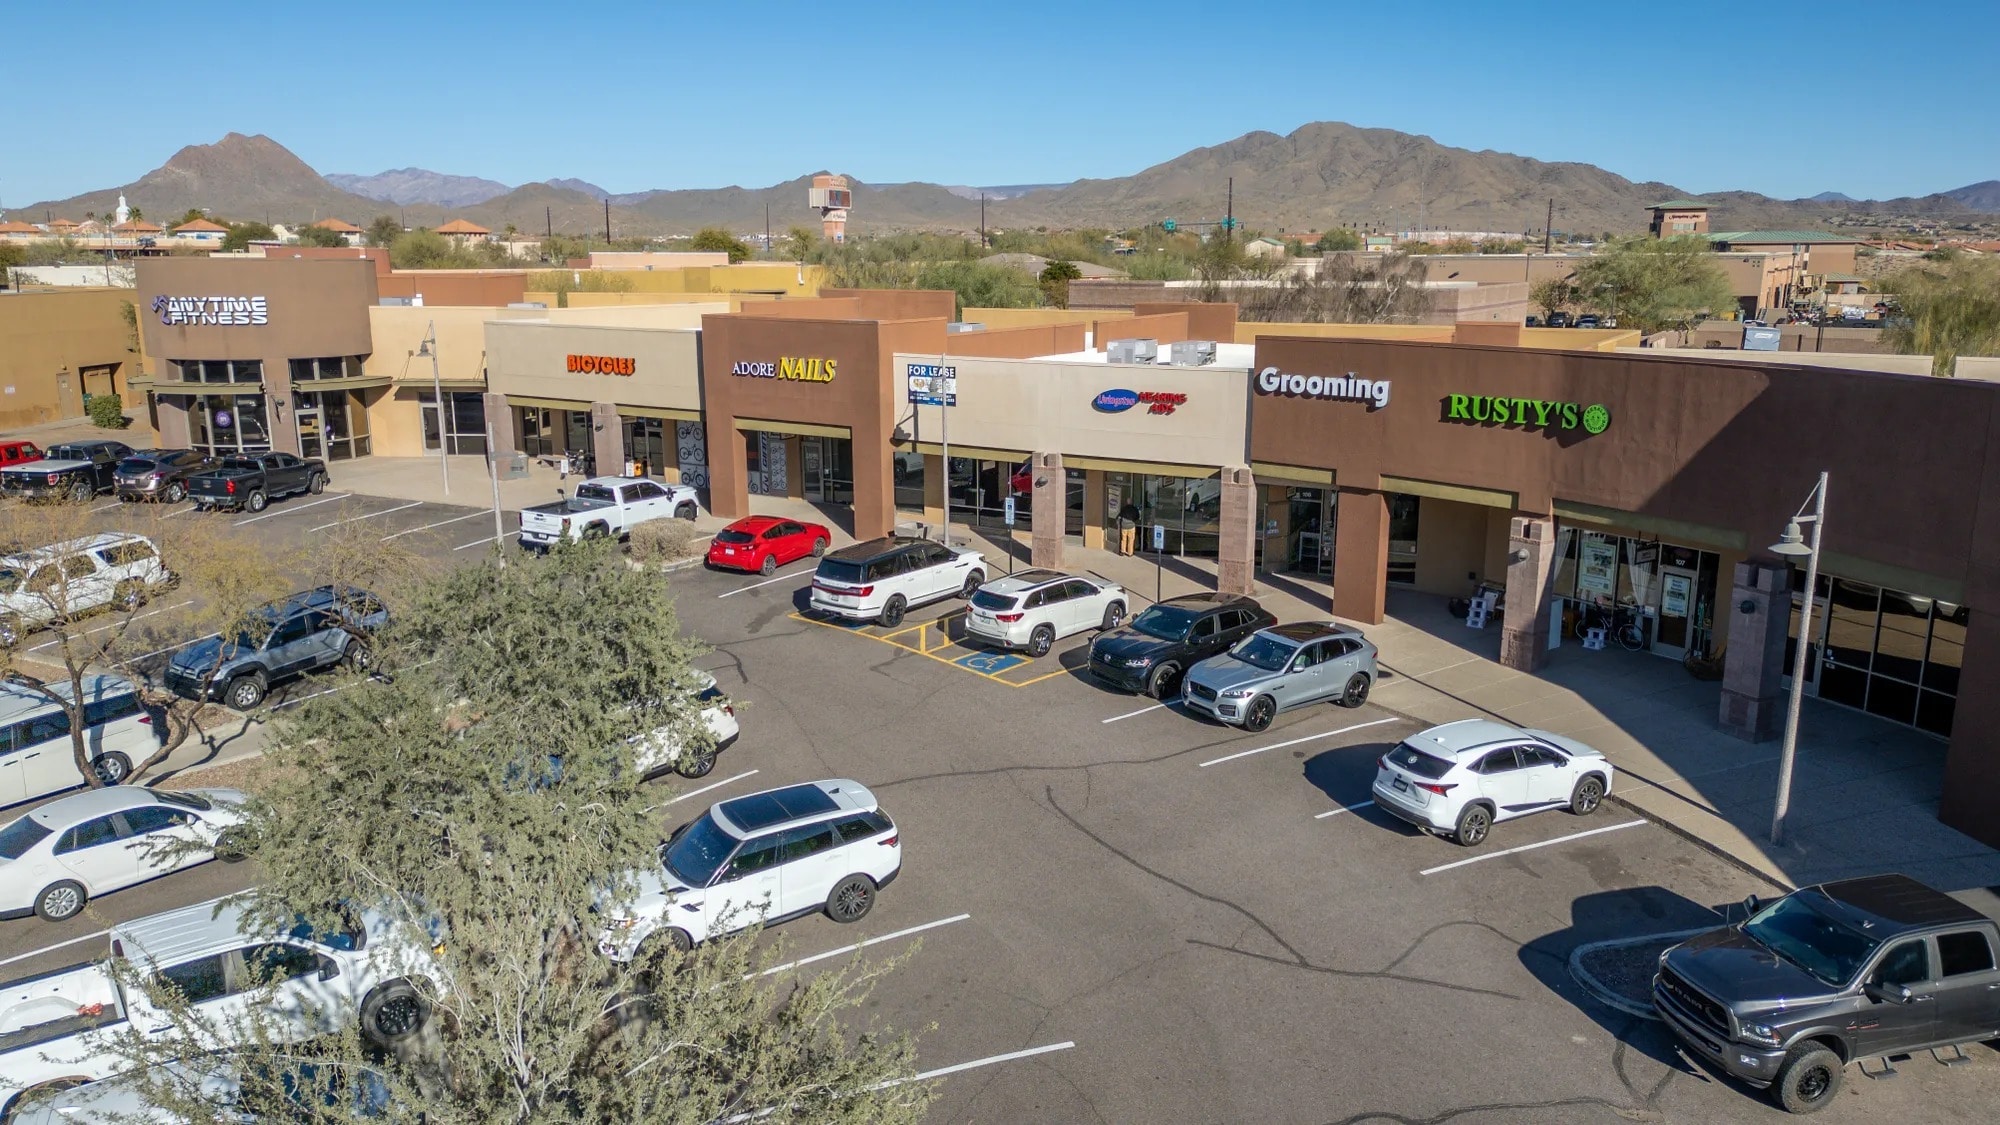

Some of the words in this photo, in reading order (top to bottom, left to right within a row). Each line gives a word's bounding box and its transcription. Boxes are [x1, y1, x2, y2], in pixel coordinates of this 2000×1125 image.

[168, 296, 267, 312] ANYTIME
[170, 311, 268, 325] FITNESS
[566, 354, 636, 376] BICYCLES
[731, 361, 776, 377] ADORE
[778, 356, 838, 383] NAILS
[908, 365, 927, 376] FOR
[1259, 366, 1391, 409] Grooming
[1148, 402, 1176, 414] AIDS
[1447, 393, 1580, 430] RUSTY'S
